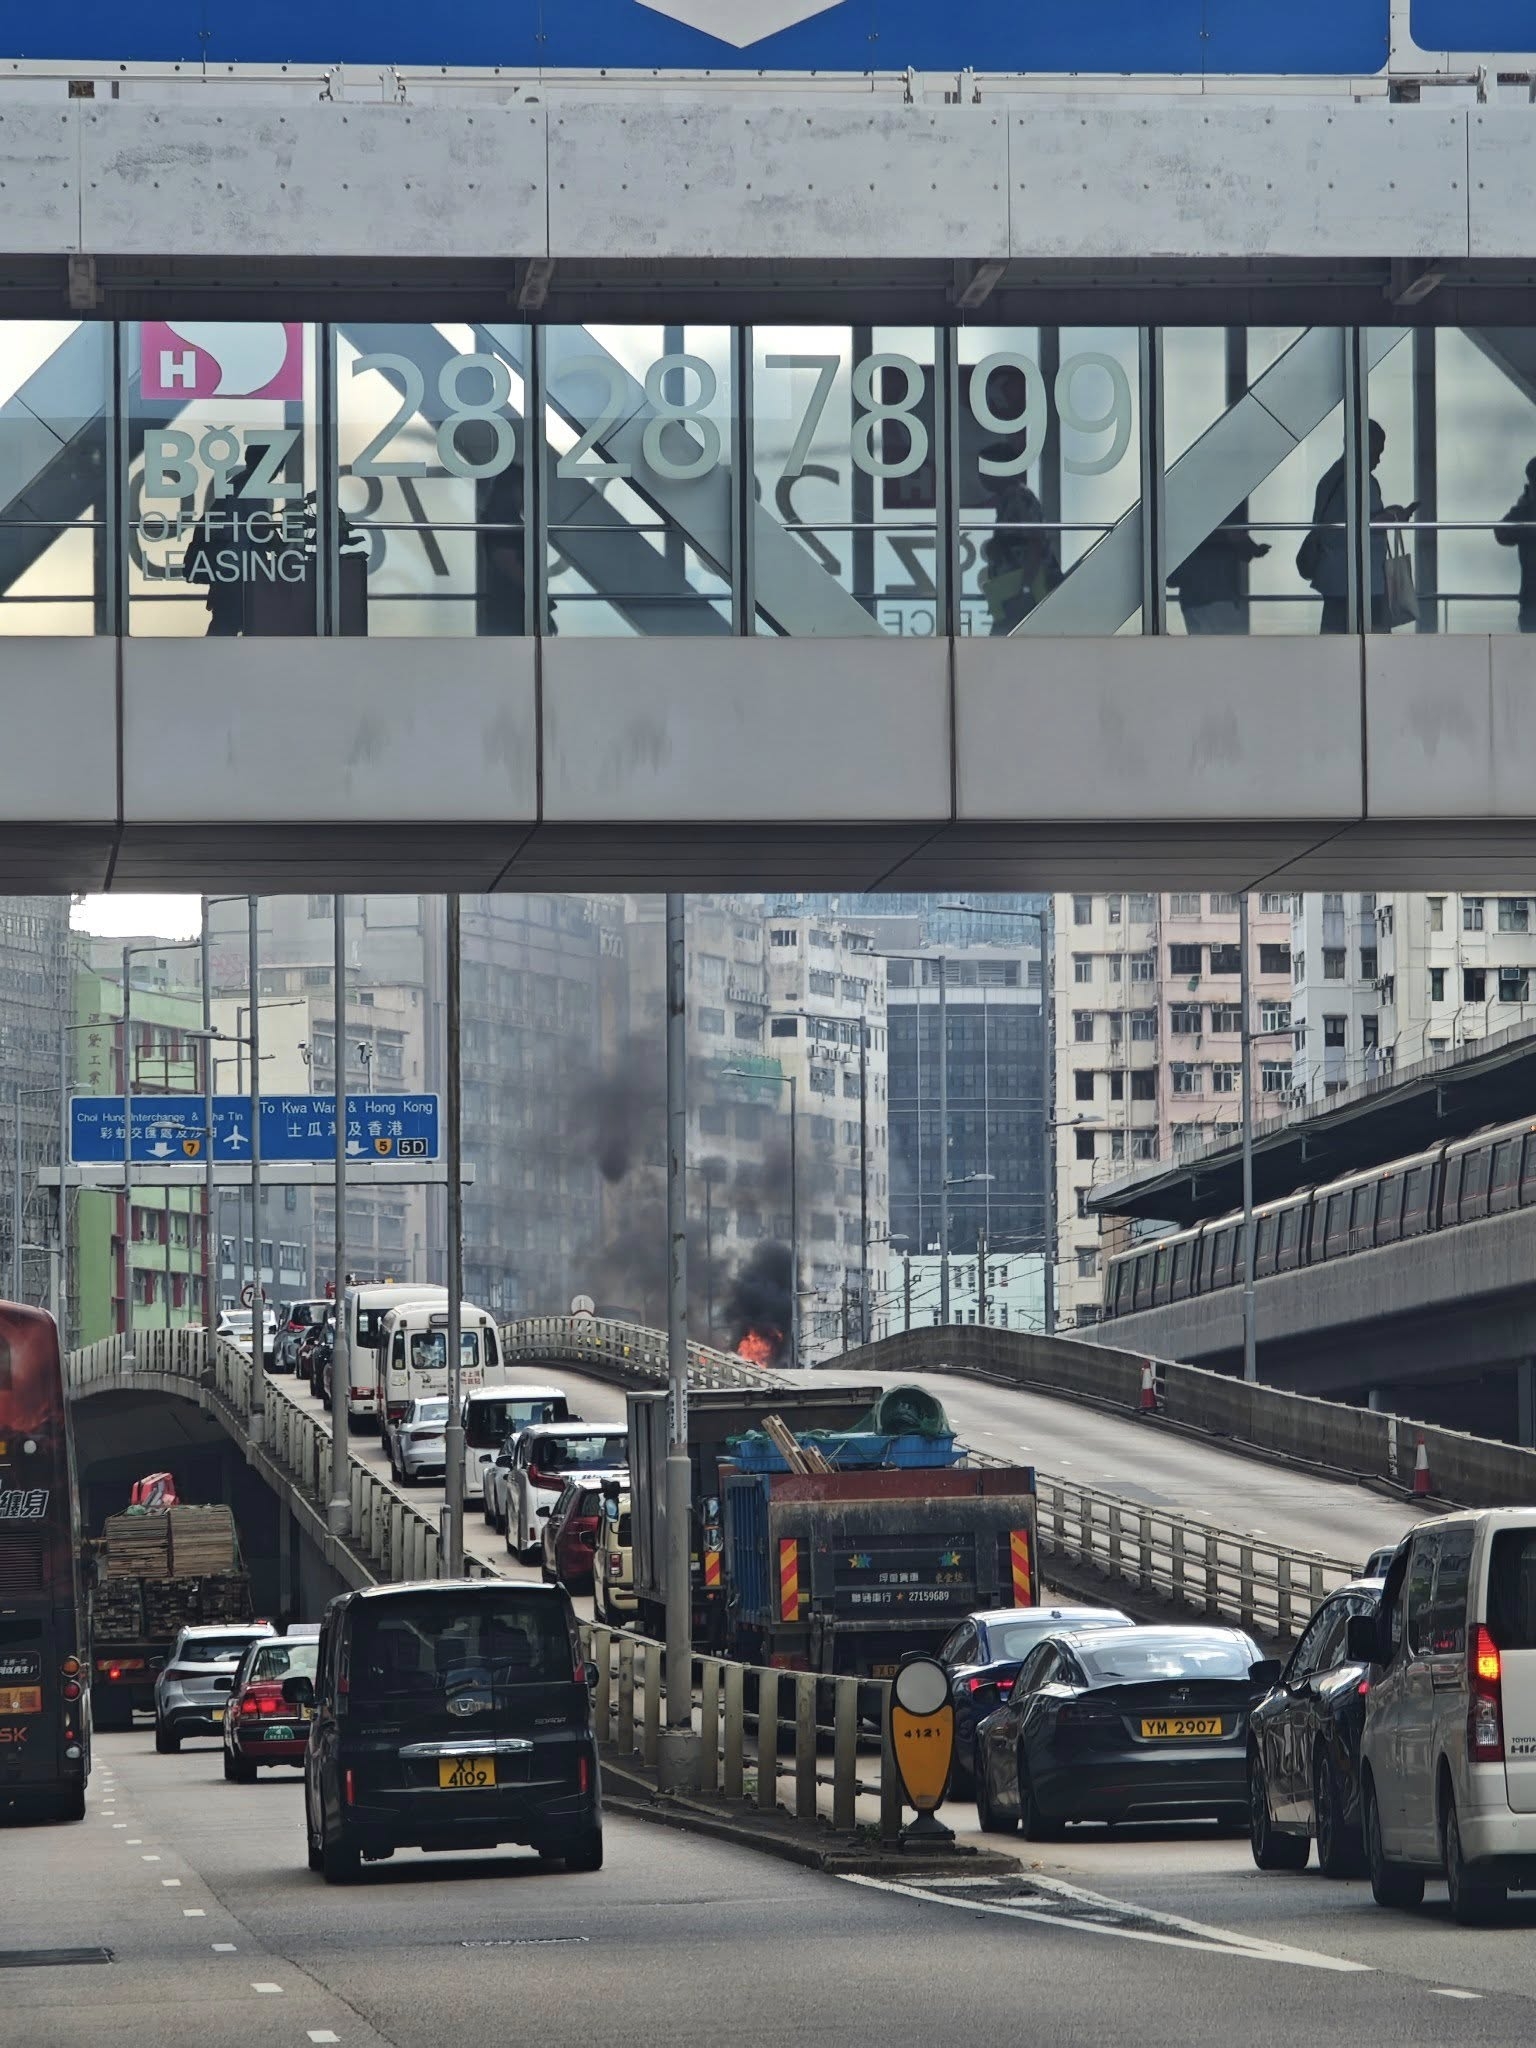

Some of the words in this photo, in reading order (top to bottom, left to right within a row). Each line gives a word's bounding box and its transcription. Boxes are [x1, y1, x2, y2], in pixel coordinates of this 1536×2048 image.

[351, 352, 517, 480] 28
[554, 352, 722, 480] 28
[764, 352, 930, 480] 78
[968, 350, 1133, 477] 99
[138, 511, 306, 543] OFFICE
[142, 550, 307, 583] LEASING
[260, 1102, 275, 1114] To
[282, 1102, 307, 1114] Kwa
[348, 1101, 356, 1112] &
[365, 1102, 396, 1116] Hong
[403, 1101, 433, 1115] Kong
[77, 1113, 98, 1122] Choi
[102, 1113, 126, 1124] Hung
[130, 1112, 186, 1124] Interchange
[191, 1112, 199, 1121] &
[228, 1111, 244, 1121] Tin
[185, 1143, 195, 1155] 7
[379, 1141, 388, 1152] 5
[400, 1140, 424, 1154] 5D
[908, 1590, 950, 1602] 27159689
[904, 1728, 941, 1740] 4121
[1146, 1721, 1167, 1735] YM
[1174, 1720, 1217, 1734] 2907
[455, 1758, 478, 1772] XT
[448, 1771, 488, 1787] 4109
